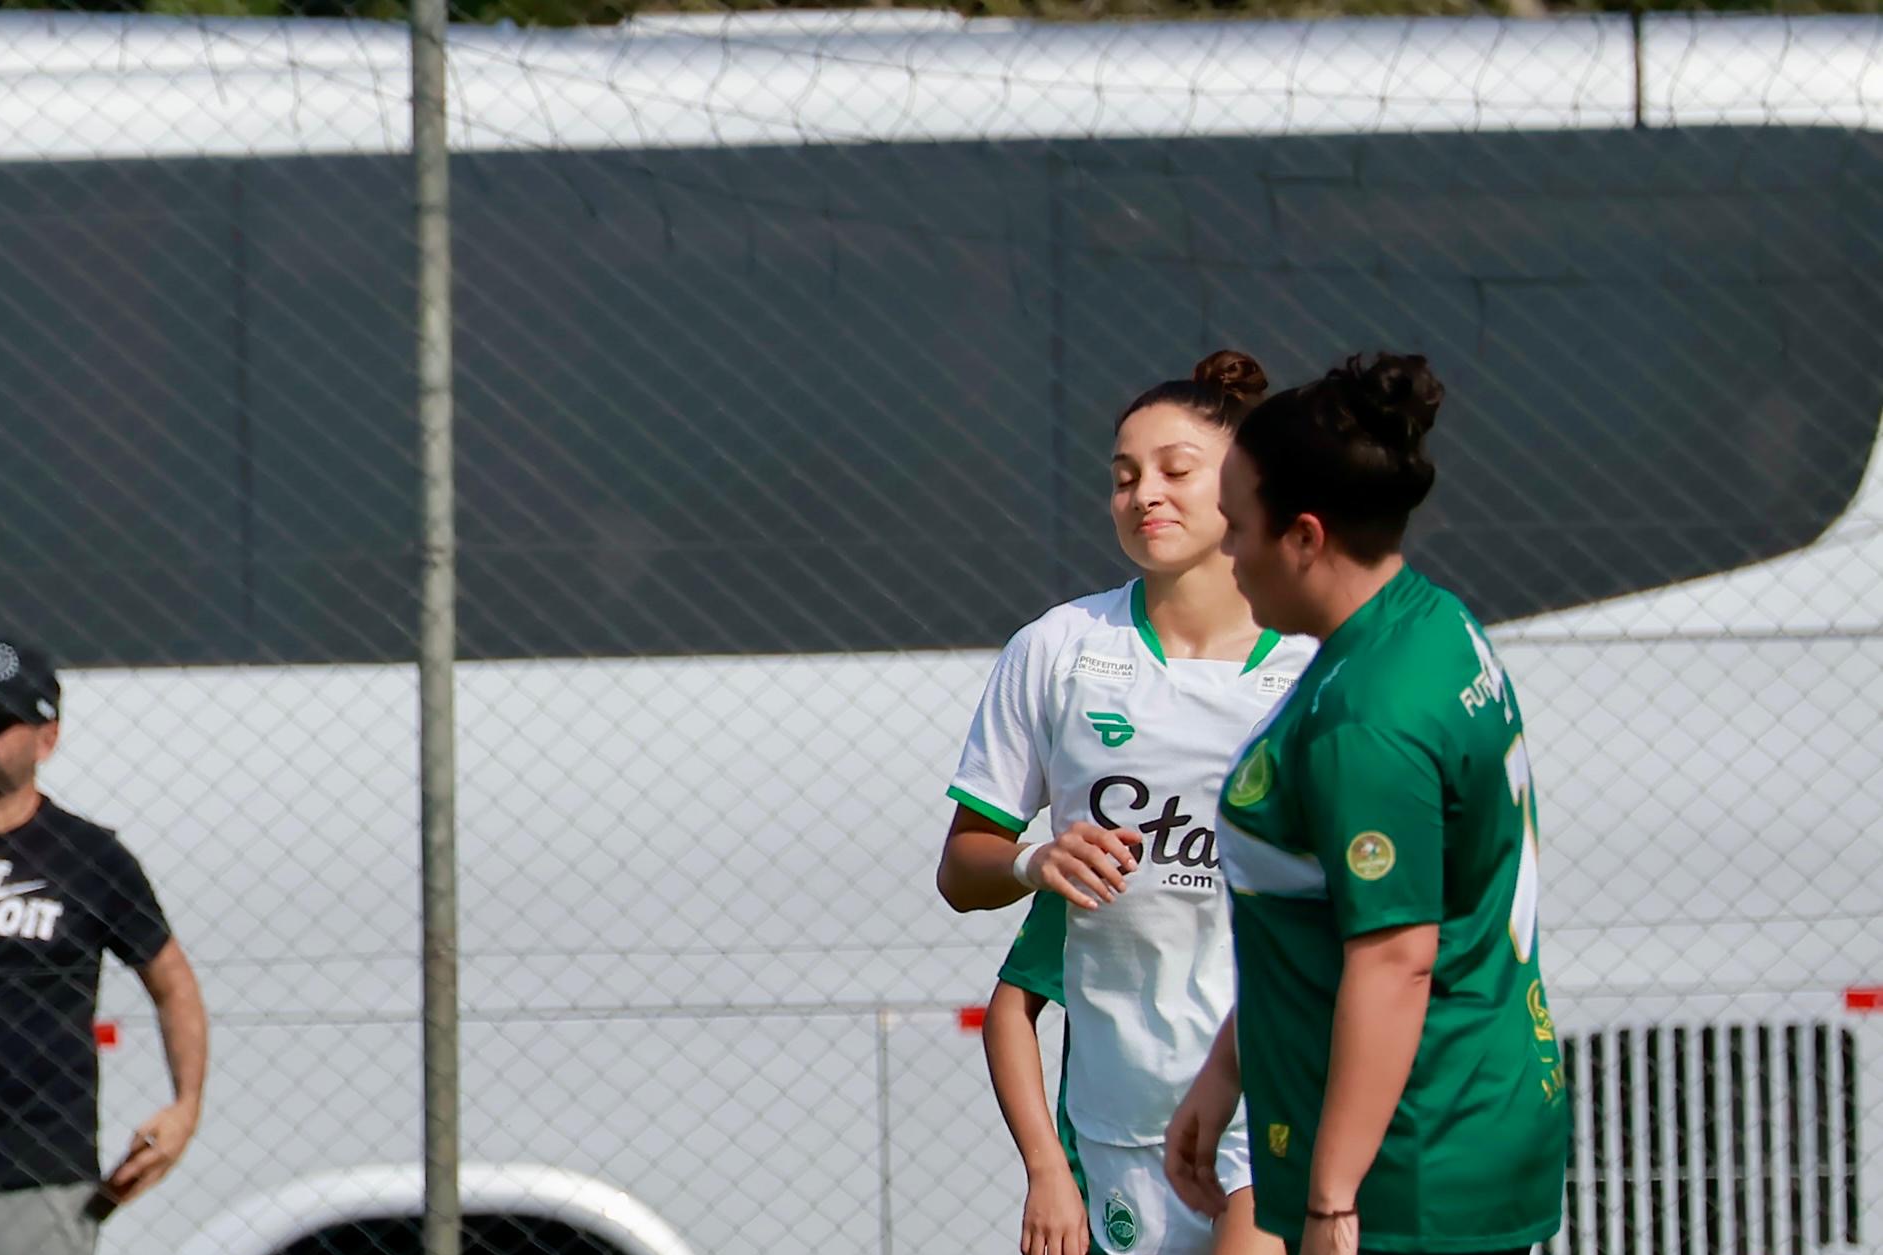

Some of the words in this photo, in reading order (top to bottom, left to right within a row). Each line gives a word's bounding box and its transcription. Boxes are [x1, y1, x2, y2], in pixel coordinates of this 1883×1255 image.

[1079, 655, 1133, 671] PREFEITURA
[1162, 873, 1213, 888] .com
[20, 897, 64, 941] IT
